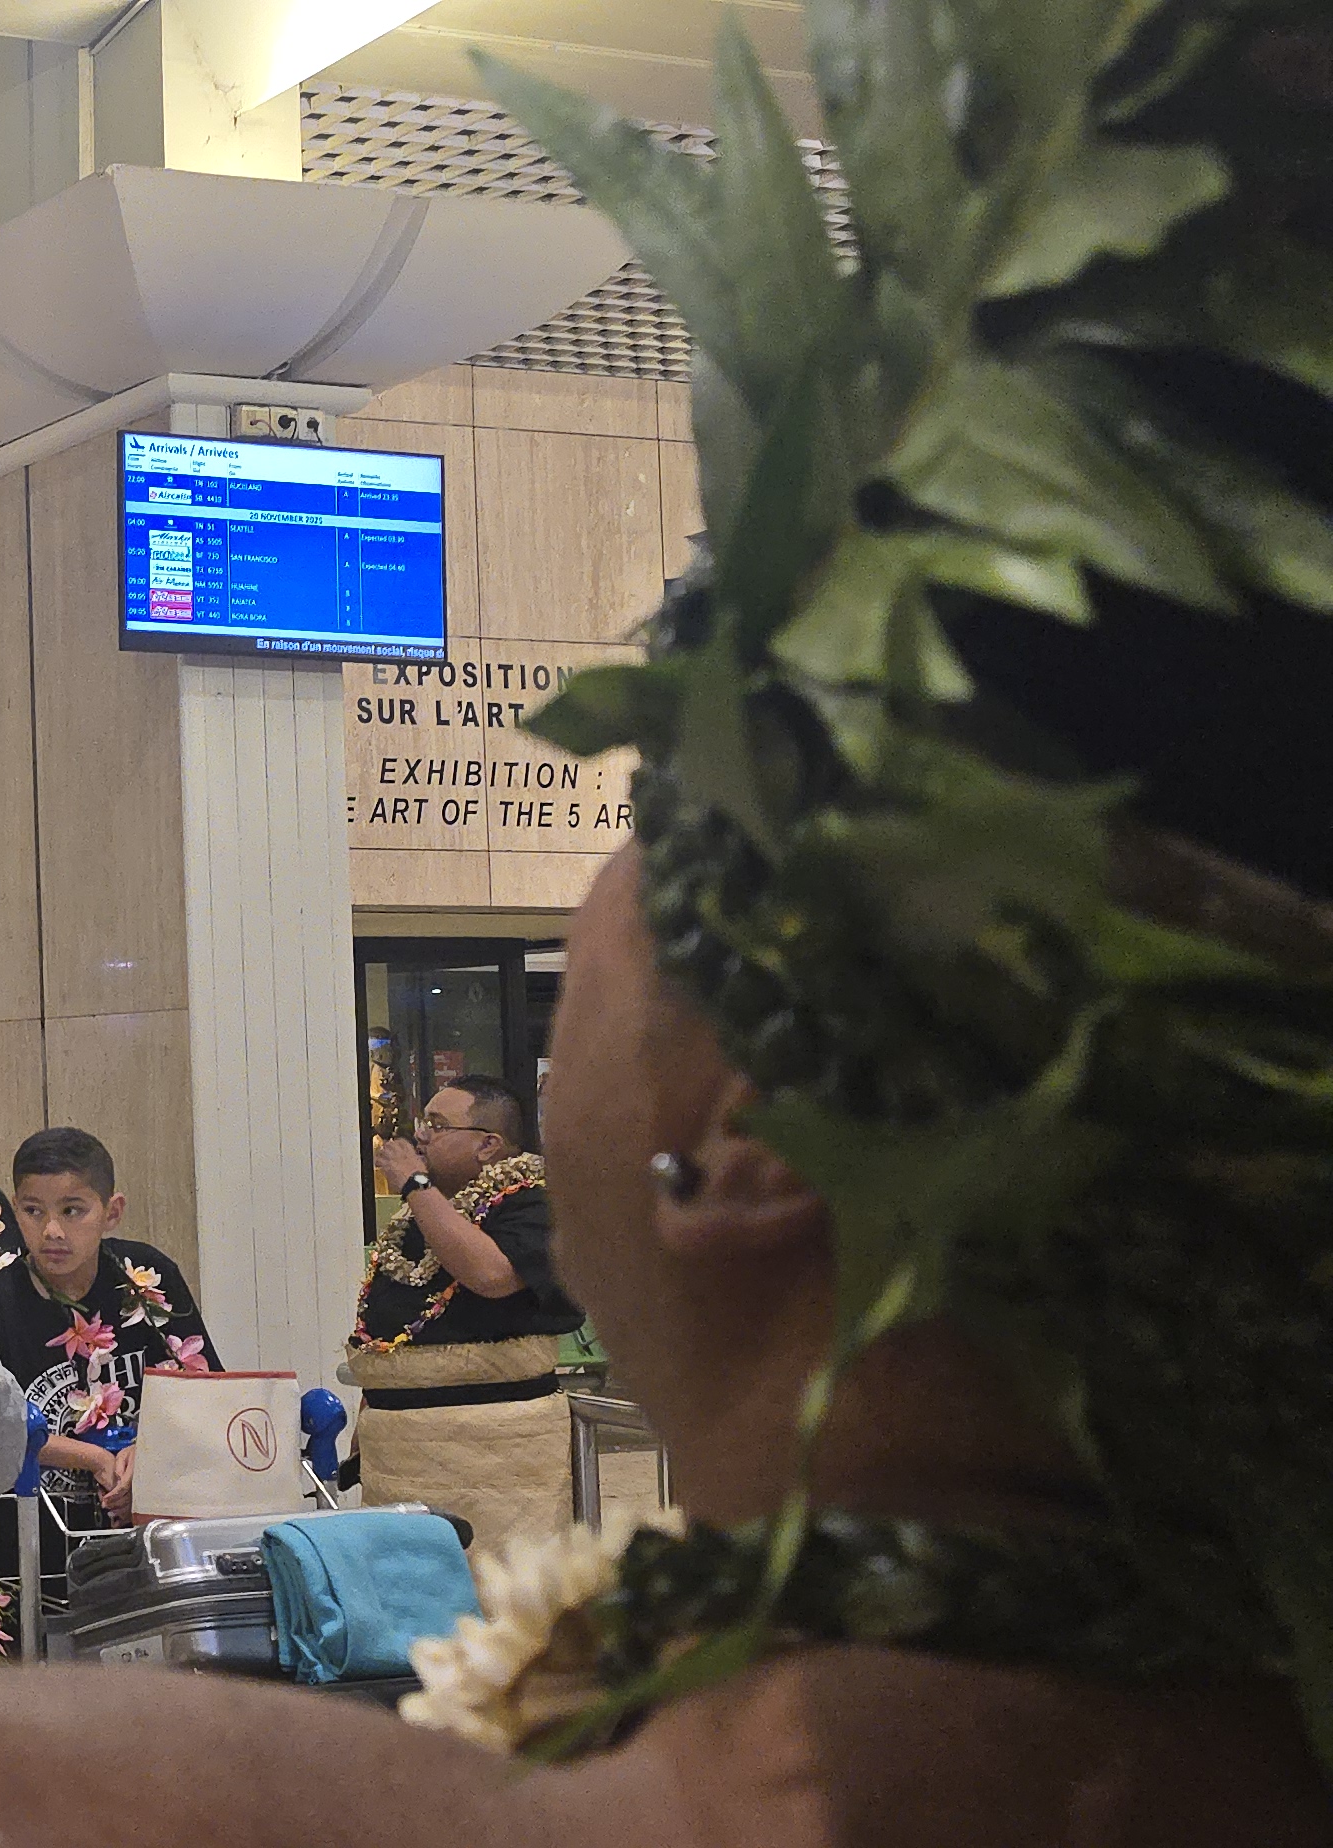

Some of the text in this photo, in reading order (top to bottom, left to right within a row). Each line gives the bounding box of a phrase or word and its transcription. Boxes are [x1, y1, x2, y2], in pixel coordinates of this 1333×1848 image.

[149, 442, 239, 459] Arrivals / Arrivées
[249, 511, 259, 520] 20
[260, 513, 304, 523] NOVEMBER
[229, 525, 255, 534] SEATTLE
[361, 534, 387, 543] Expected
[244, 555, 278, 564] FRANCISCO
[361, 562, 388, 570] Expected
[231, 598, 257, 606] RAIATEA
[231, 612, 248, 621] BORA
[250, 613, 267, 622] BORA
[256, 638, 270, 649] En
[271, 640, 300, 651] raison
[302, 641, 322, 653] d'un
[323, 643, 375, 656] mouvement
[377, 647, 406, 659] social,
[407, 648, 435, 660] risque
[373, 661, 573, 693] EXPOSITION
[357, 697, 525, 729] SUR L'ART
[379, 757, 579, 790] EXHIBITION
[369, 797, 429, 824] ART
[441, 799, 479, 826] OF
[499, 801, 555, 828] THE
[567, 803, 580, 828] 5
[240, 1419, 270, 1458] N
